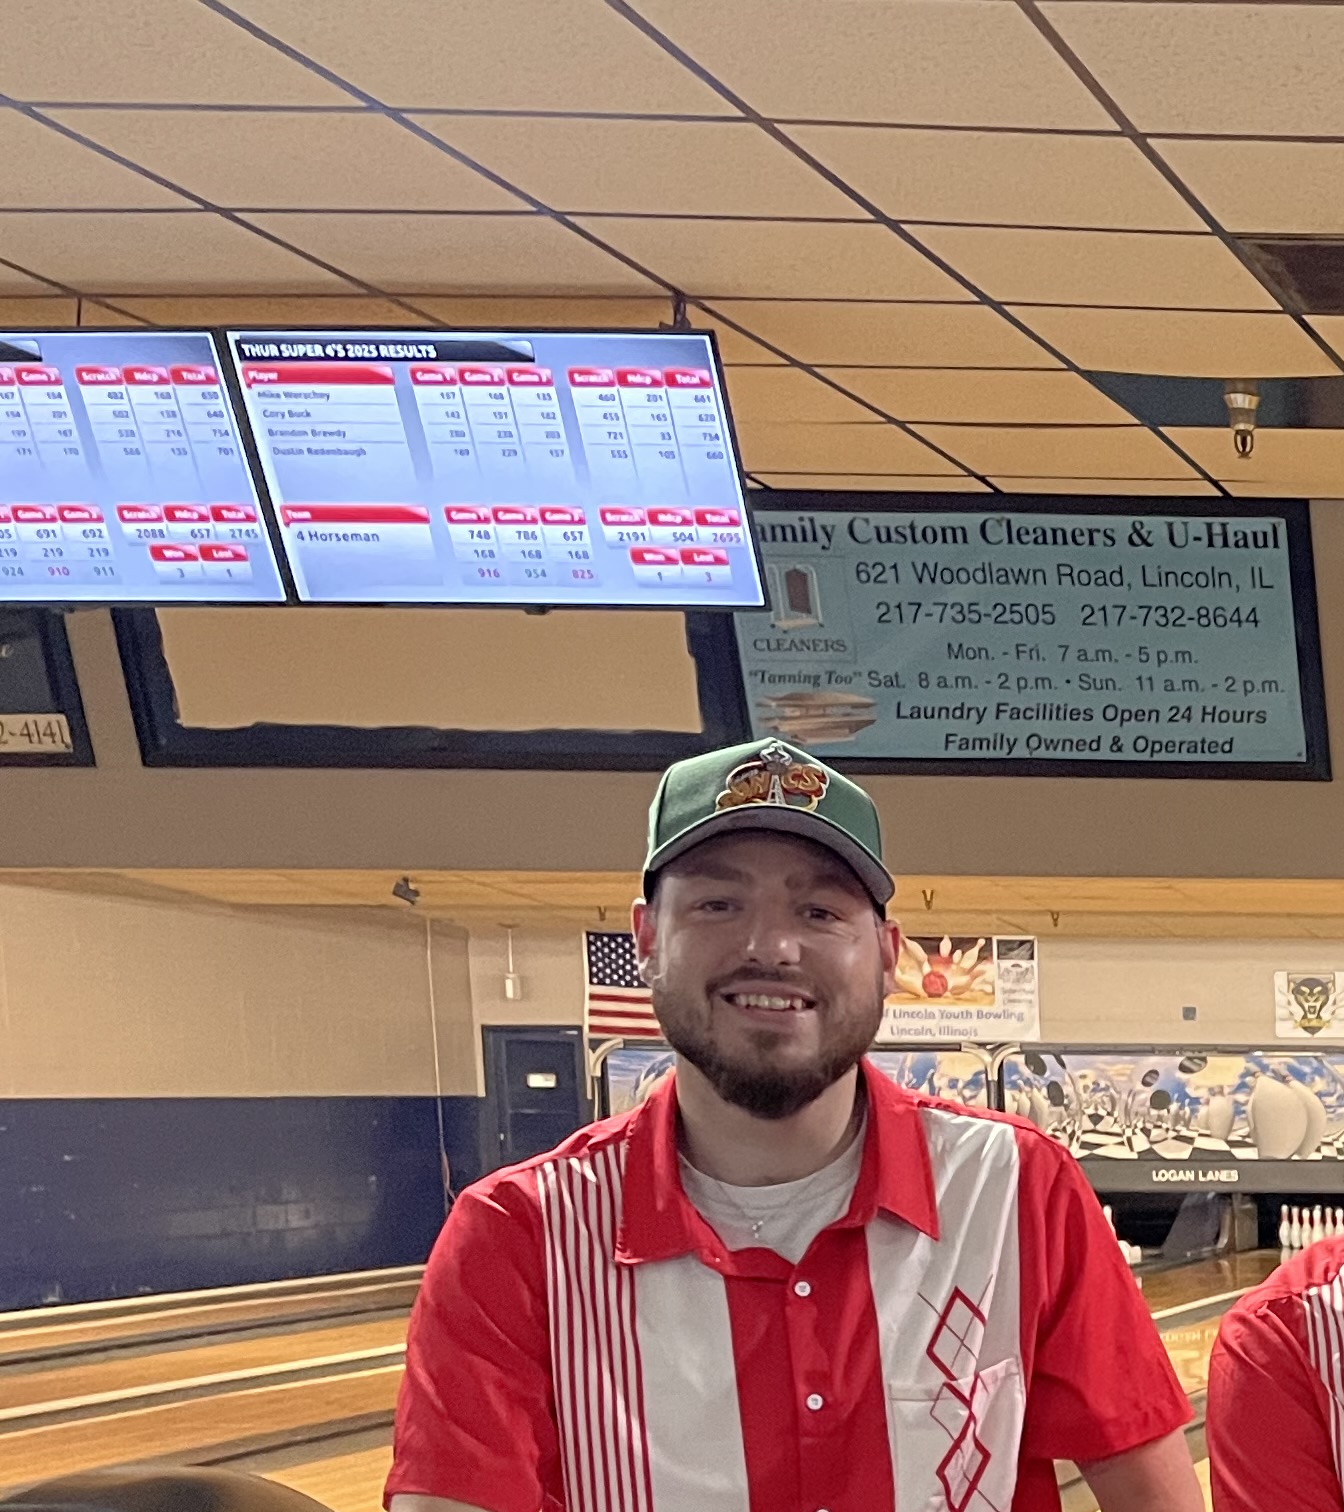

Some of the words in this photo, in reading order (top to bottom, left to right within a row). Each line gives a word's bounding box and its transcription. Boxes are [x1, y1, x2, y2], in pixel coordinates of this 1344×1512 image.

[241, 343, 280, 358] THUR
[281, 343, 325, 358] SUPER
[346, 344, 378, 358] 2025
[379, 344, 437, 359] RESULTS
[308, 530, 381, 543] Horseman
[755, 516, 836, 550] amily
[848, 516, 969, 546] Custom
[979, 517, 1116, 547] Cleaners
[1127, 520, 1153, 548] &
[1165, 521, 1281, 549] U-Haul
[856, 562, 900, 585] 621
[912, 561, 1047, 586] Woodlawn
[1057, 563, 1132, 591] Road,
[1142, 565, 1240, 593] Lincoln,
[1251, 566, 1275, 590] IL
[876, 602, 1056, 626] 217-735-2505
[1081, 604, 1260, 628] 217-732-8644
[753, 638, 848, 653] CLEANERS
[896, 702, 987, 725] Laundry
[995, 703, 1094, 722] Facilities
[1102, 703, 1160, 727] Open
[1167, 706, 1193, 723] 24
[1201, 706, 1268, 724] Hours
[945, 733, 1018, 756] Family
[1026, 733, 1101, 752] Owned
[1109, 736, 1124, 753] &
[1133, 735, 1235, 758] Operated
[939, 1009, 974, 1020] Youth
[976, 1009, 1025, 1023] Bowling
[938, 1025, 979, 1038] Illinois
[1152, 1170, 1195, 1182] LOGAN
[1198, 1170, 1239, 1182] LANES
